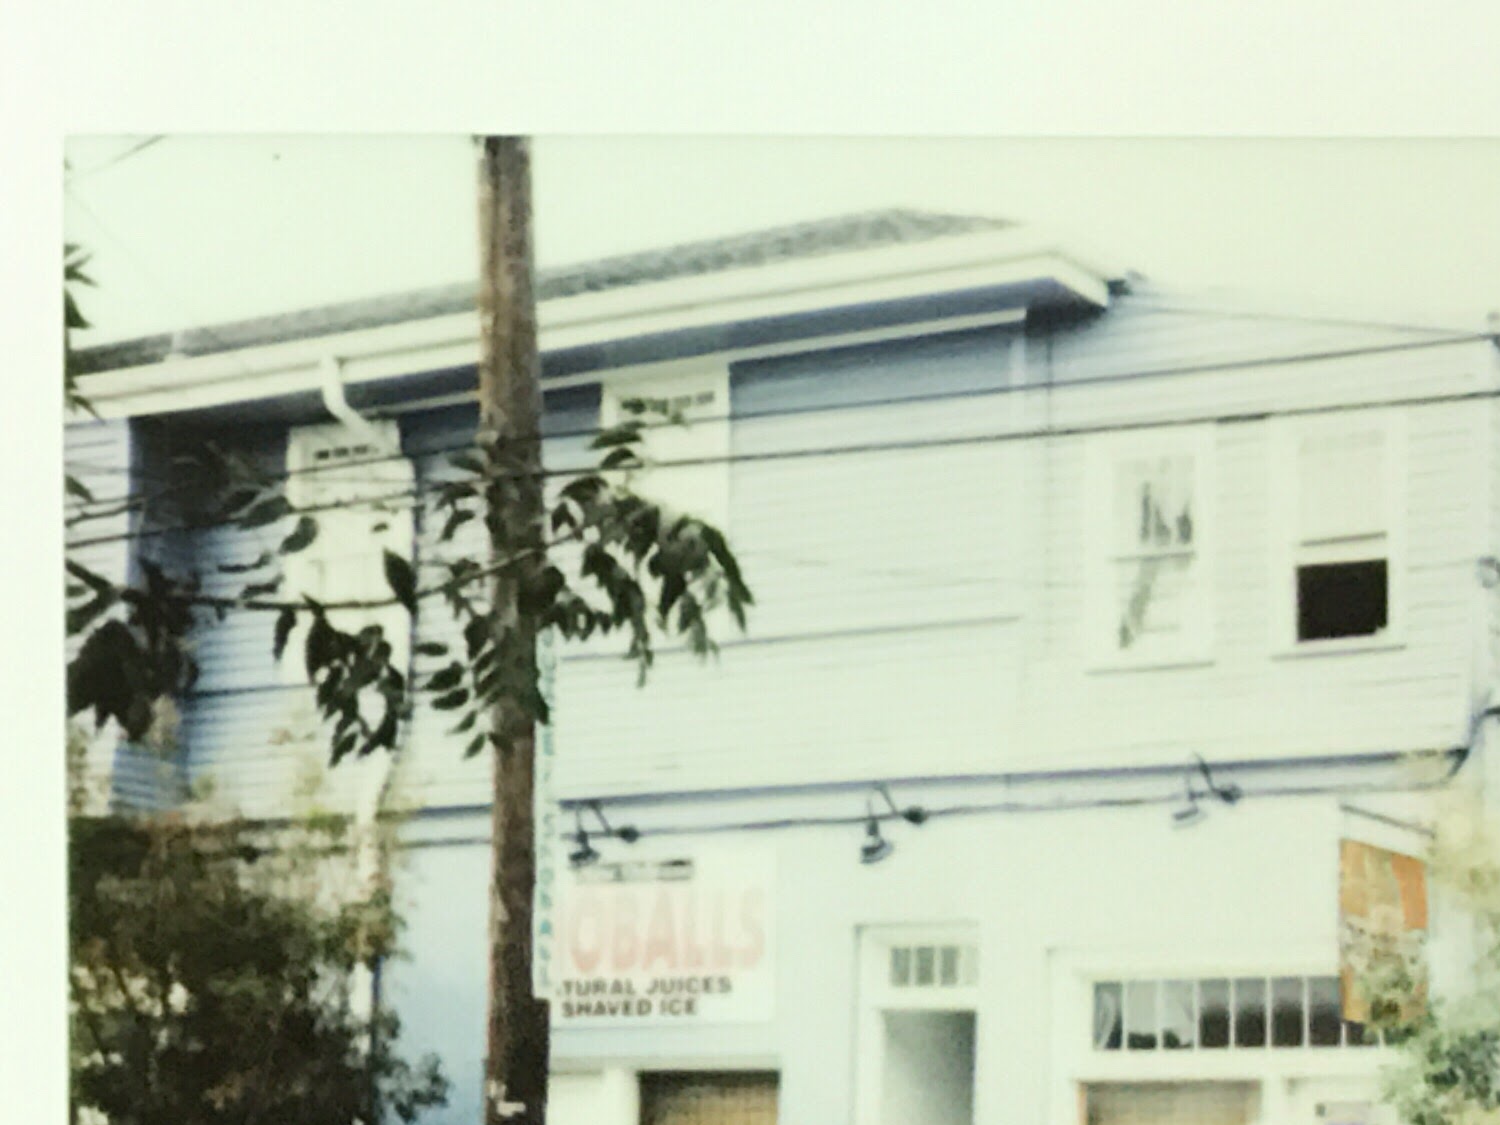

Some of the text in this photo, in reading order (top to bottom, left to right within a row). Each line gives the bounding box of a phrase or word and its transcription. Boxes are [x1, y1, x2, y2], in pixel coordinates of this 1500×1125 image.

[557, 976, 733, 996] TURAL JUICES
[561, 998, 698, 1017] SHAVED ICE
